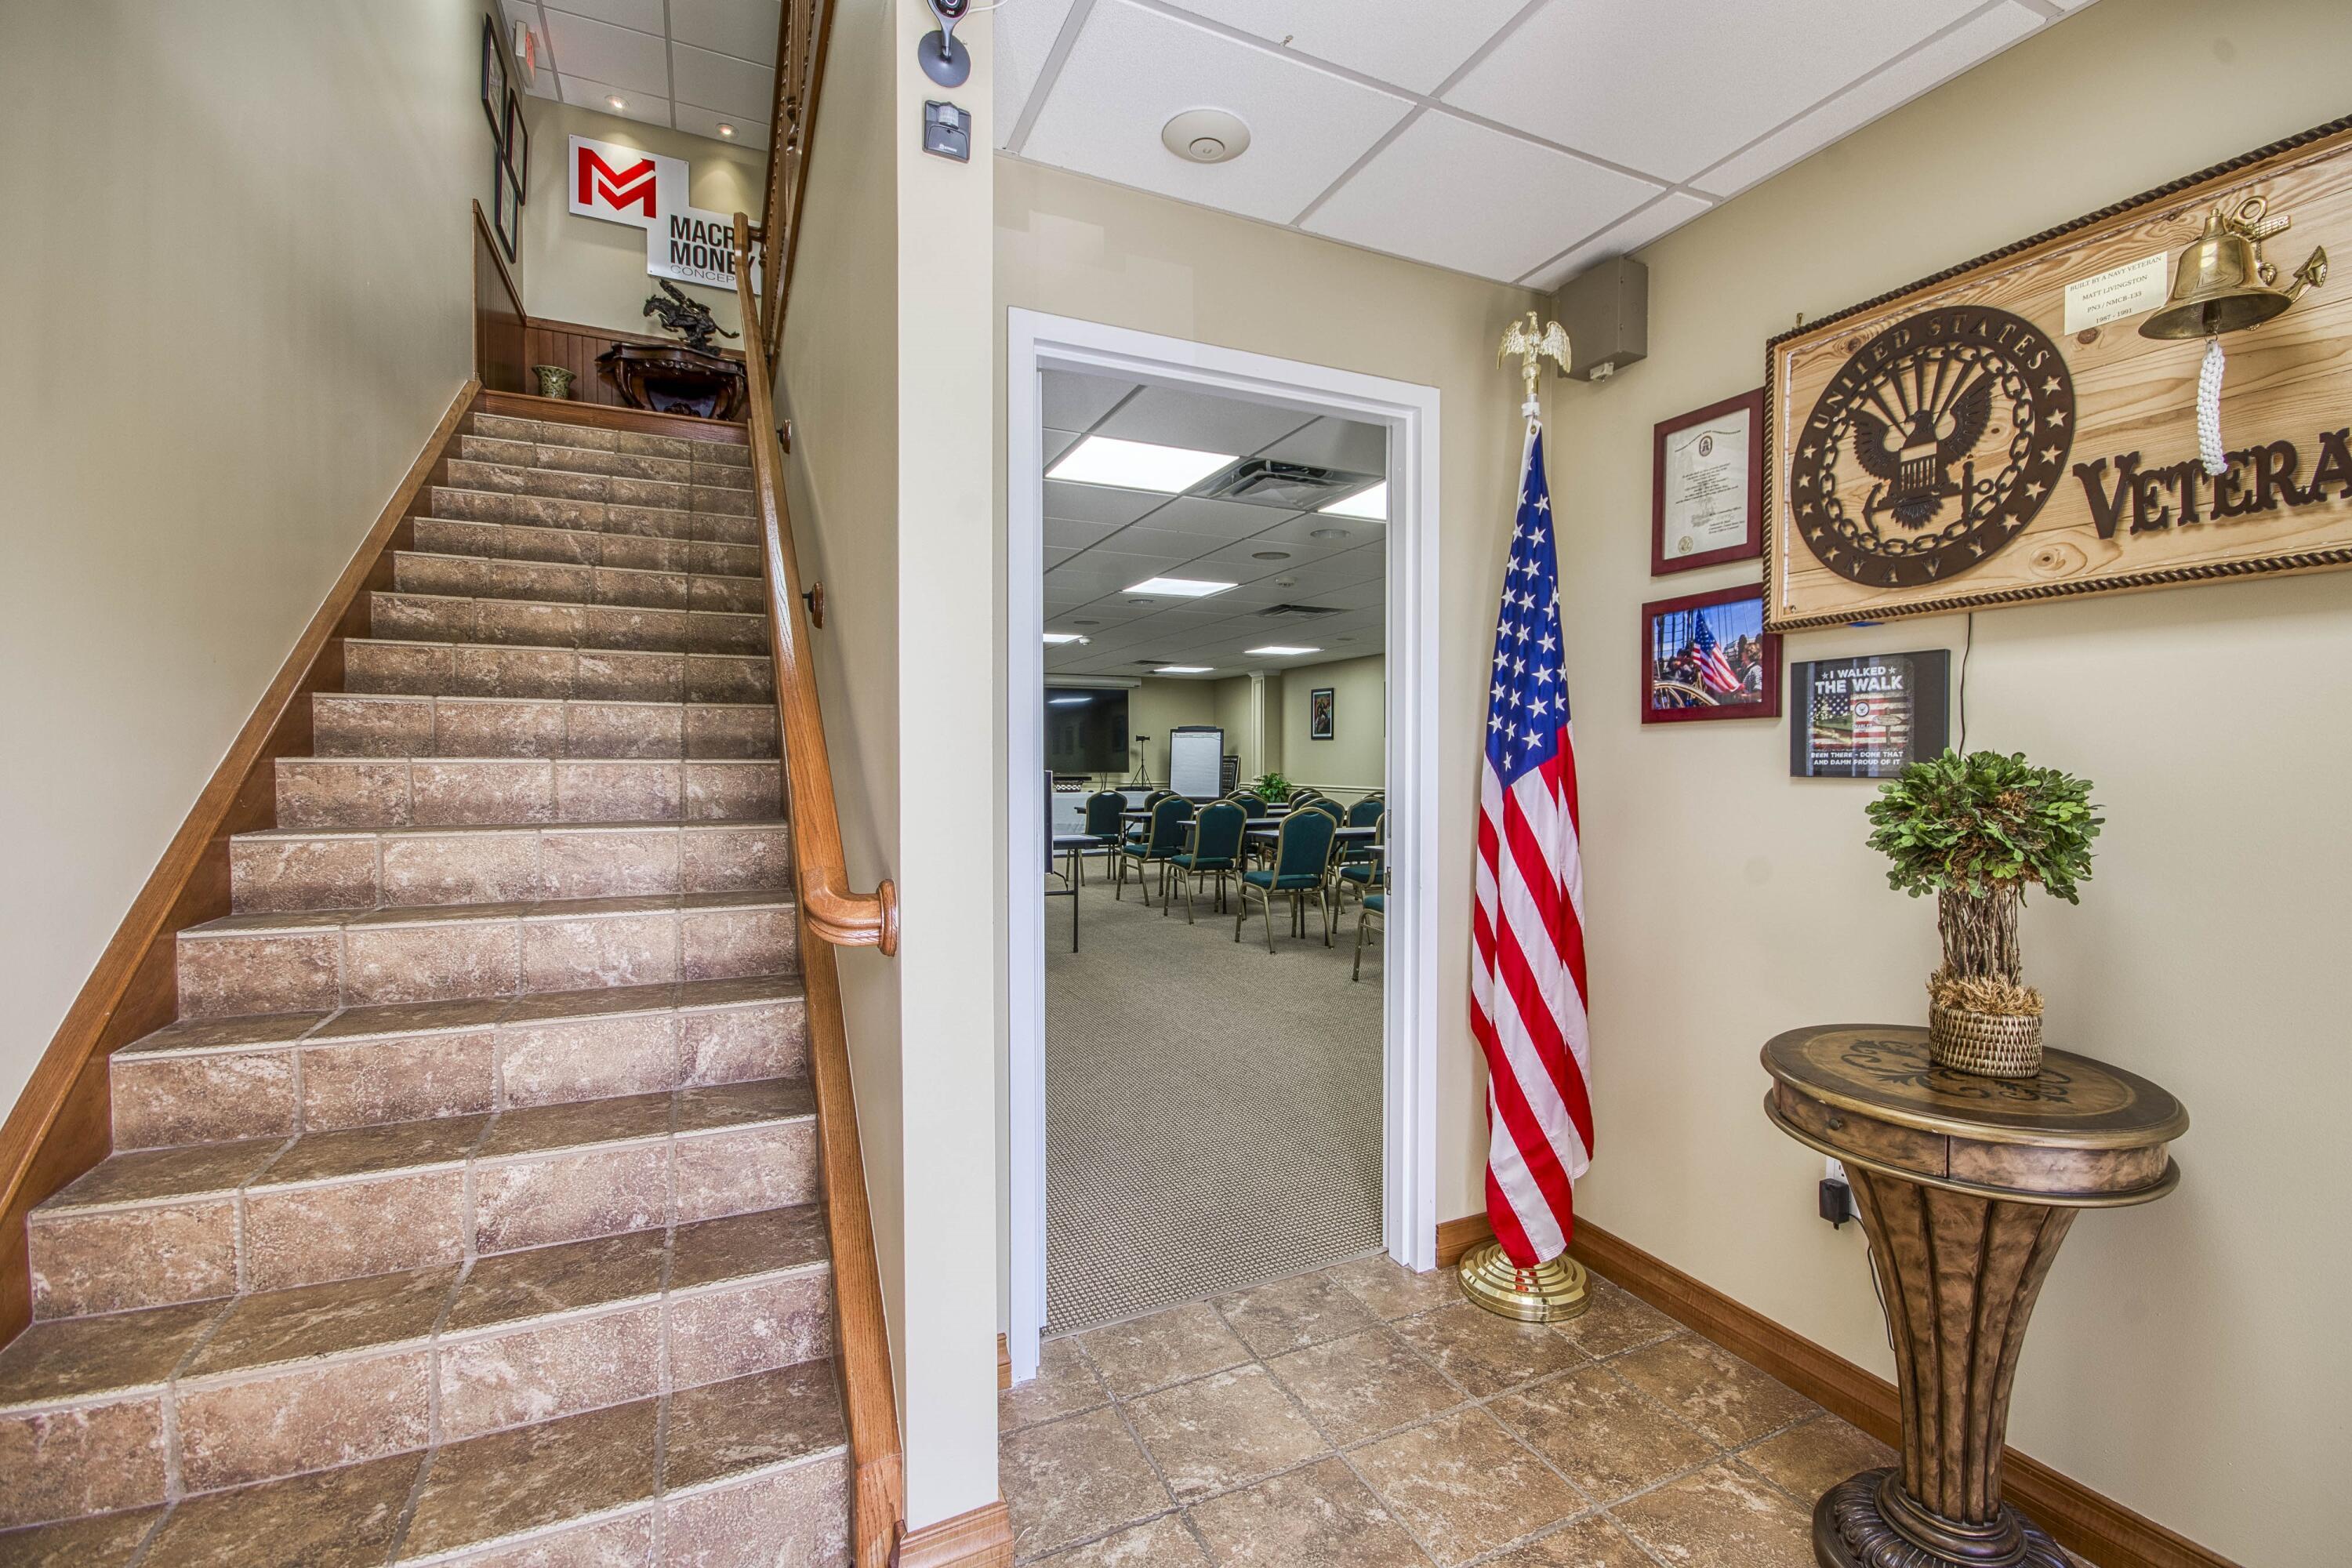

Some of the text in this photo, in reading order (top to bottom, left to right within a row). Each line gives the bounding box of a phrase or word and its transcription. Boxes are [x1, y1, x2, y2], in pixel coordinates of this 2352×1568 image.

[670, 214, 753, 252] MACR
[670, 265, 735, 283] CONCEP
[2070, 280, 2090, 292] BUILT
[2107, 269, 2126, 279] NAVY
[2128, 256, 2161, 271] VETERAN
[2082, 274, 2148, 301] MATT LIVINGSTON
[2096, 314, 2111, 324] 1987
[2117, 308, 2132, 318] 1991
[1812, 314, 2051, 430] UNITED STATES
[1844, 535, 1986, 583] NAVY
[1815, 675, 1904, 694] THE WALK
[1830, 666, 1886, 679] I WALKED
